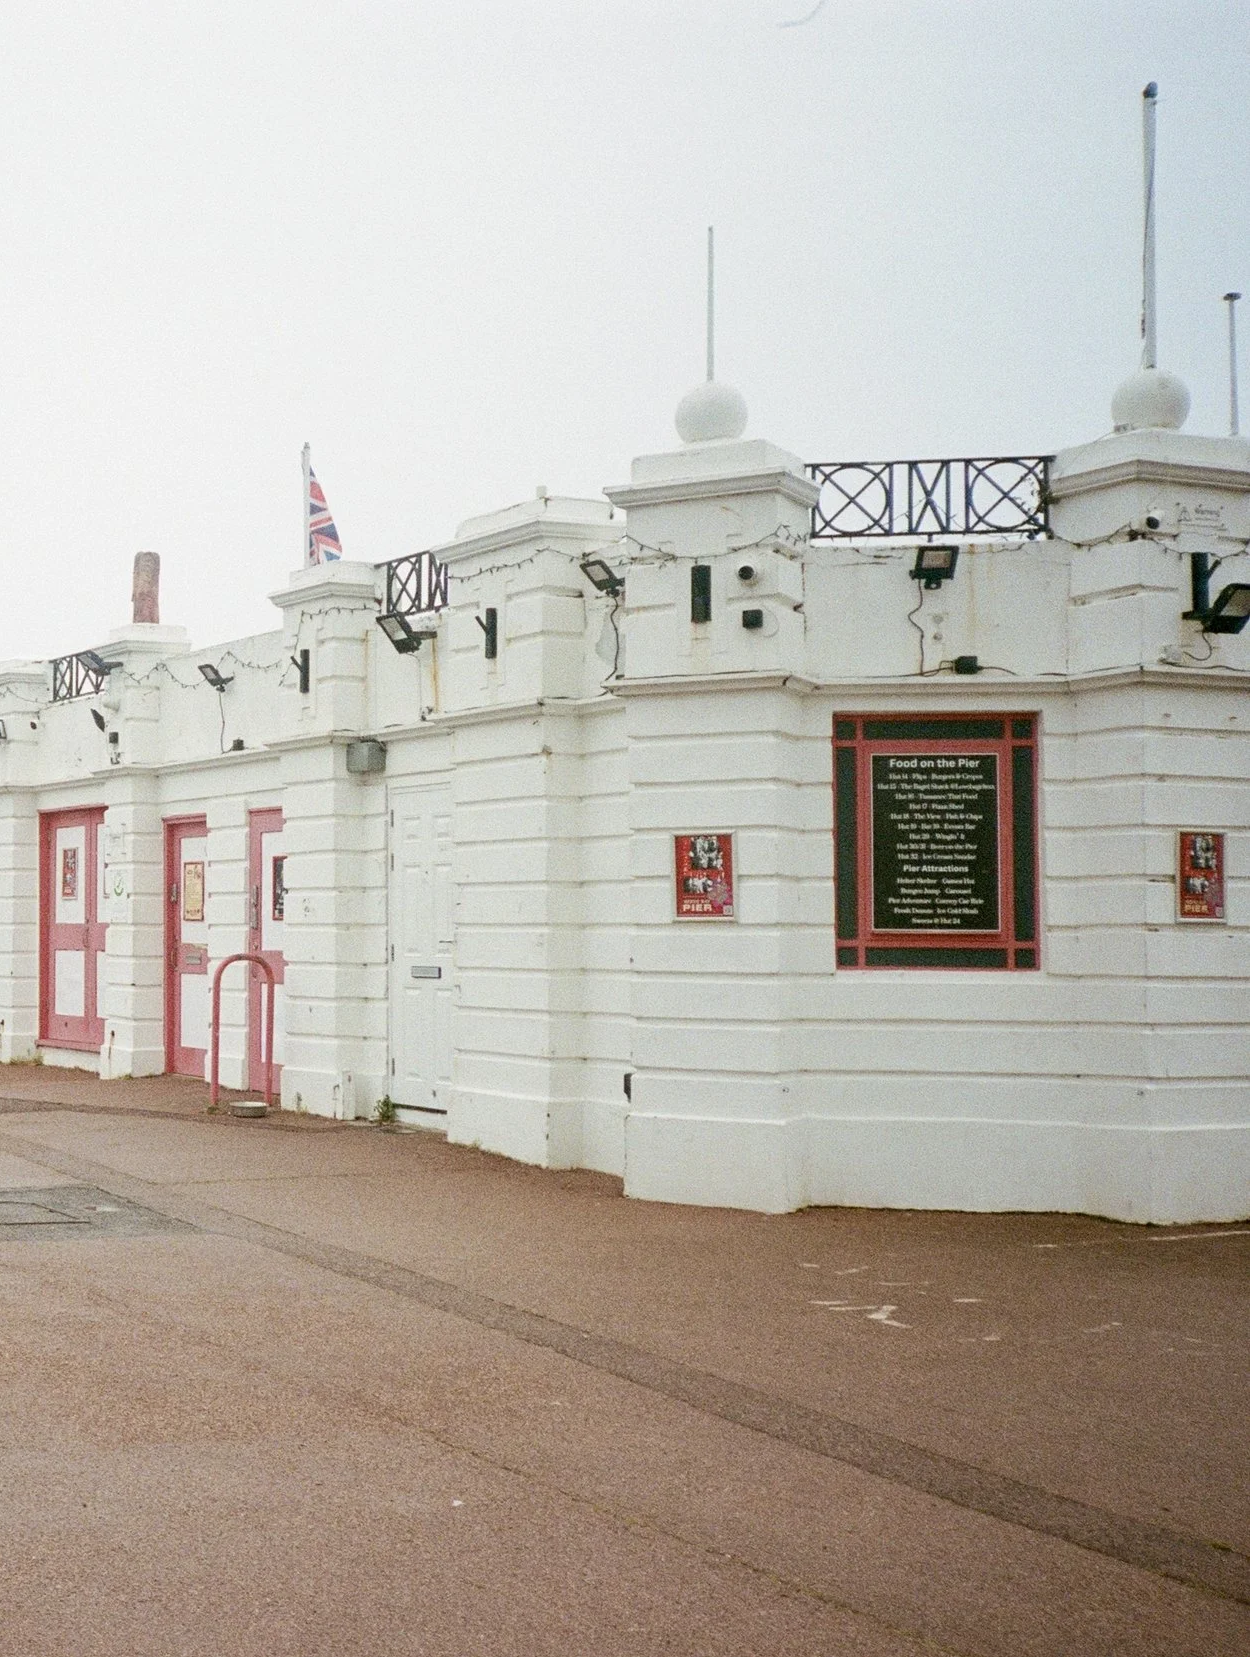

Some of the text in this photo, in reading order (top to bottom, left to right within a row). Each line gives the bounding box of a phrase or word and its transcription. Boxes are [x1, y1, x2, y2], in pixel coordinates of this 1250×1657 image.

[890, 759, 917, 768] Food
[936, 759, 956, 768] the
[958, 758, 980, 768] Pier
[682, 904, 712, 912] PIER
